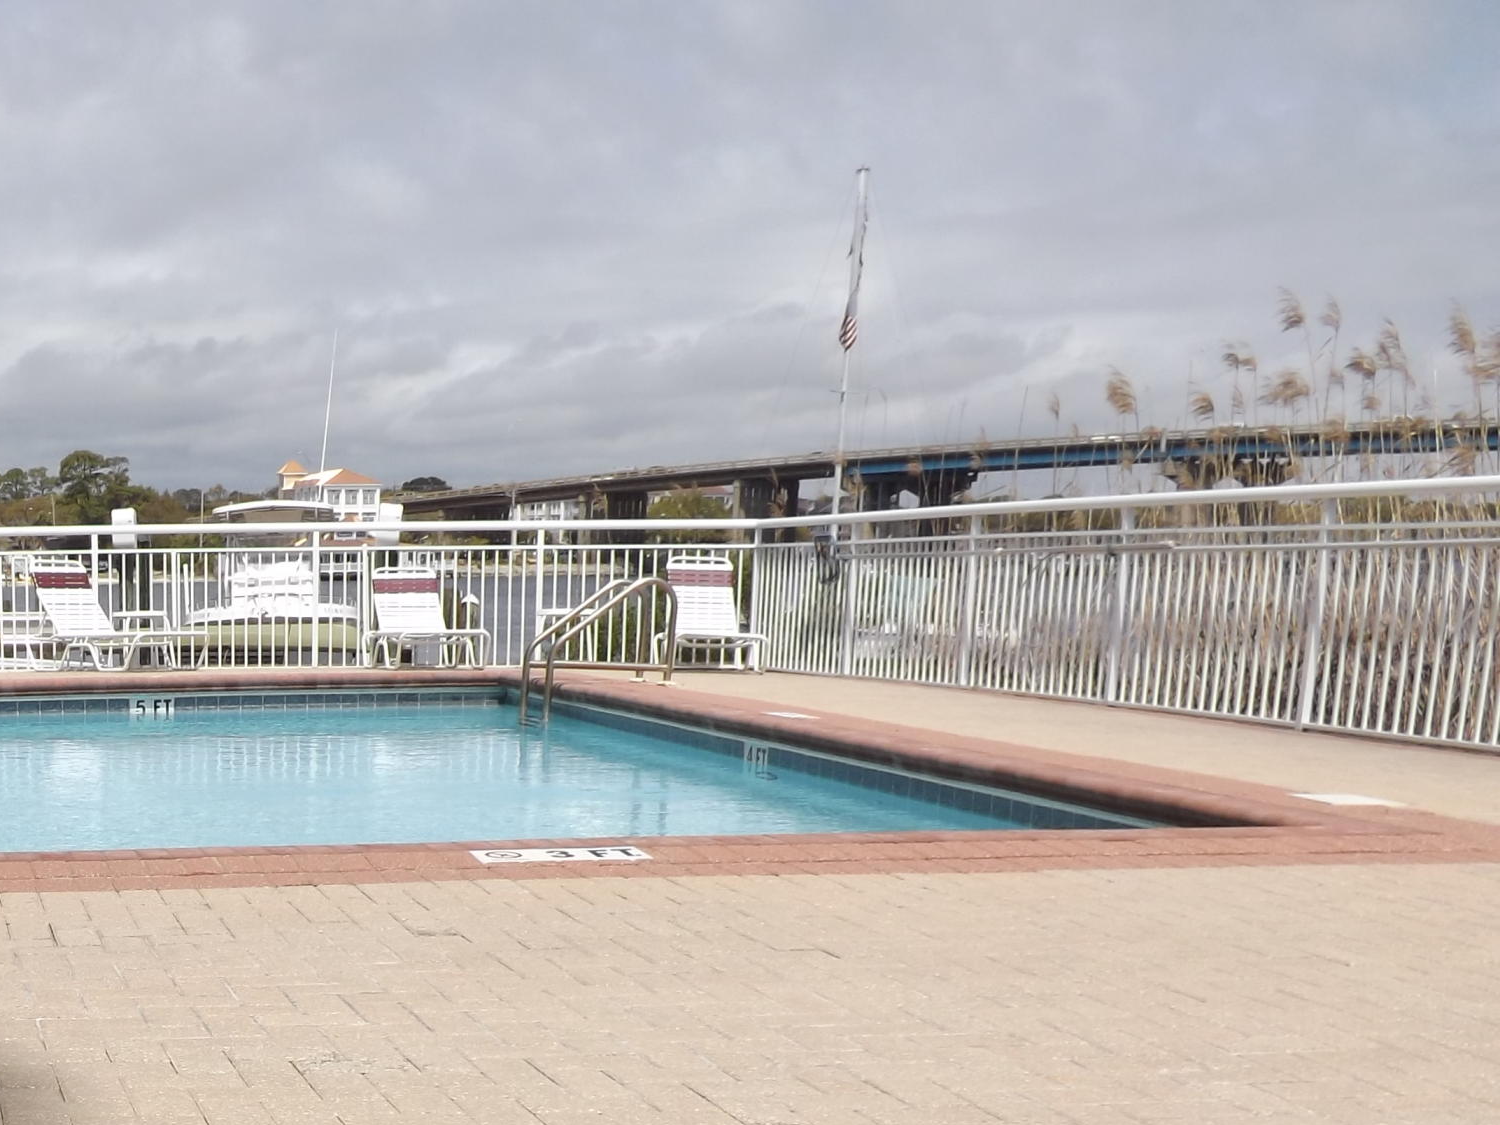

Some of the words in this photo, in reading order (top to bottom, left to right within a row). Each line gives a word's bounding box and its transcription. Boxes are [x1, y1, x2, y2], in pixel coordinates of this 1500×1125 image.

[136, 700, 146, 716] 5
[153, 699, 172, 718] FT
[747, 745, 753, 762] 4
[545, 850, 575, 858] 3
